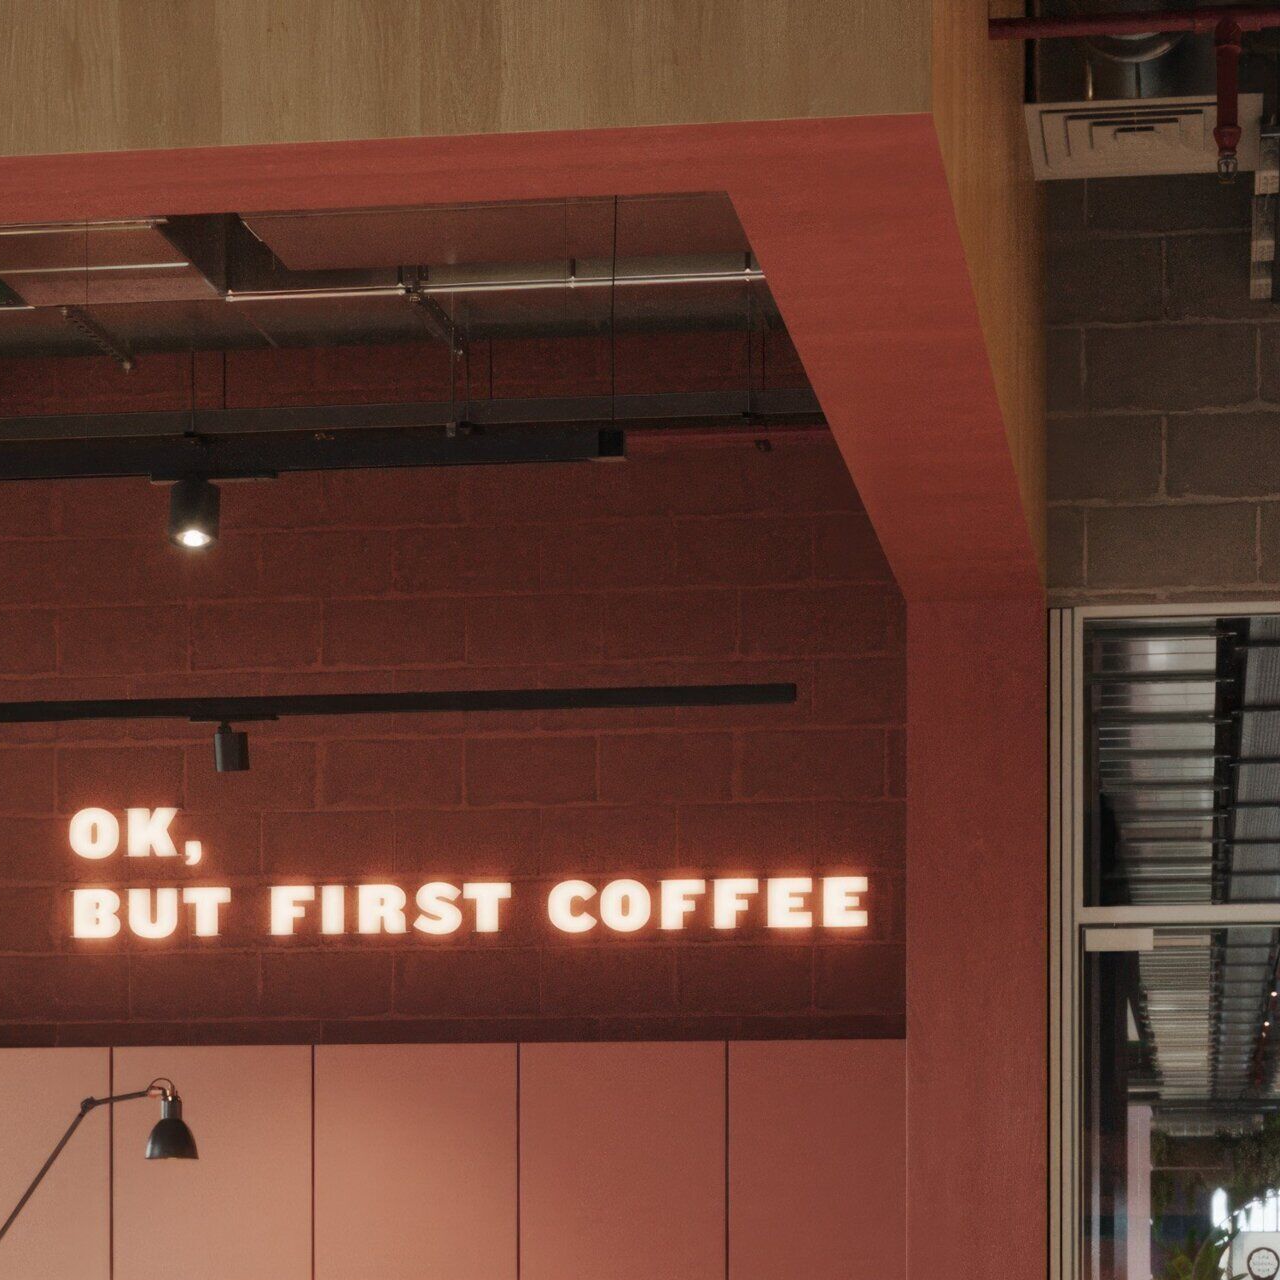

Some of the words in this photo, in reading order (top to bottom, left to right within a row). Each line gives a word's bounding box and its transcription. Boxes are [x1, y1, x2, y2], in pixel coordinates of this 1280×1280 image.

[68, 807, 203, 866] OK,
[71, 886, 232, 939] BUT
[270, 881, 512, 936] FIRST
[547, 875, 869, 933] COFFEE
